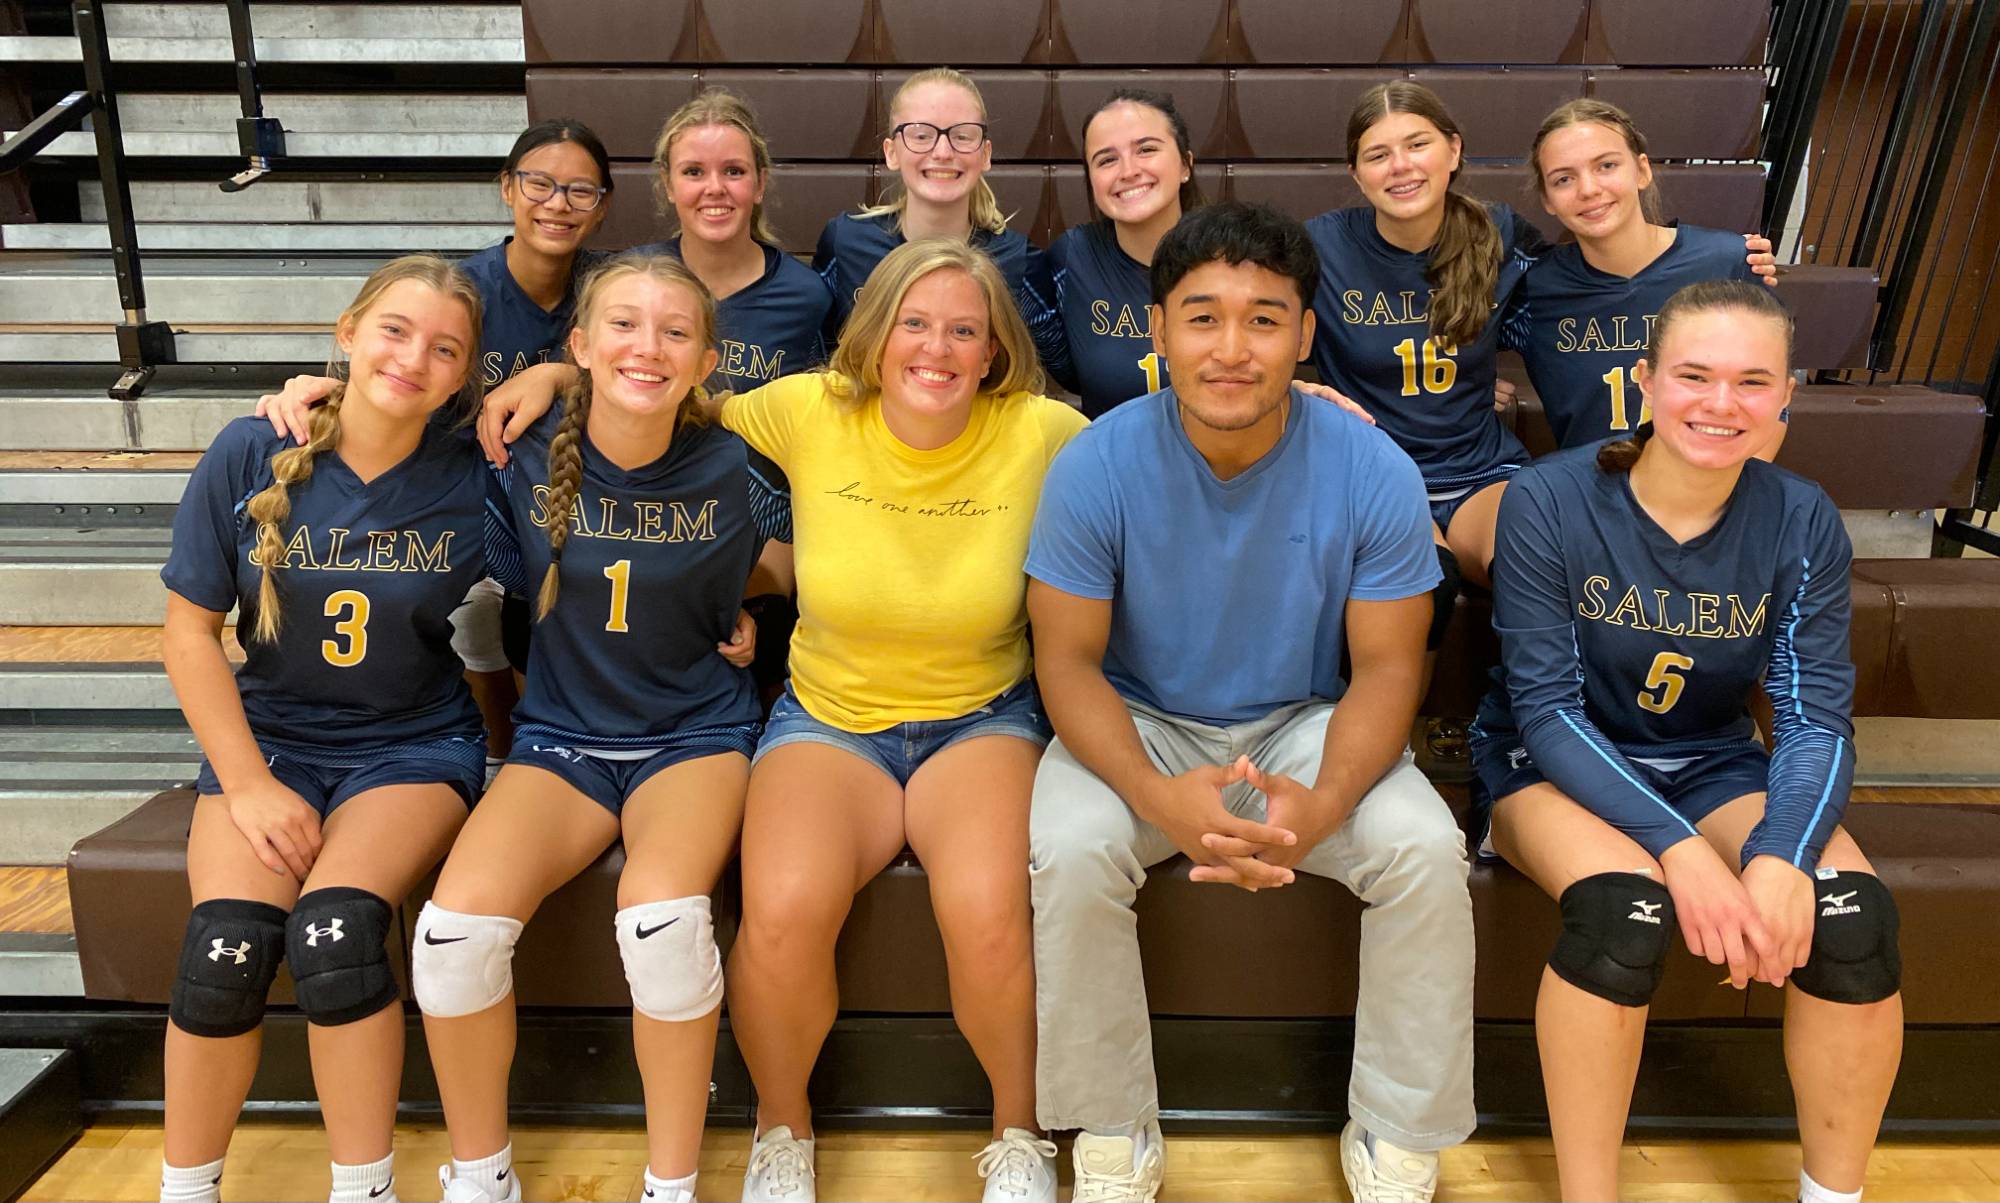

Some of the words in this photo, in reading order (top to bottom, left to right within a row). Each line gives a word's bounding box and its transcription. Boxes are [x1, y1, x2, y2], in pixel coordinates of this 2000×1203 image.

[1343, 289, 1498, 325] SAL
[1137, 352, 1169, 395] 1
[1393, 335, 1458, 397] 16
[824, 481, 873, 505] love
[881, 502, 909, 514] one
[918, 499, 992, 517] another
[603, 559, 631, 633] 1
[1578, 575, 1772, 639] SALEM
[321, 589, 371, 668] 3
[1637, 651, 1695, 714] 5
